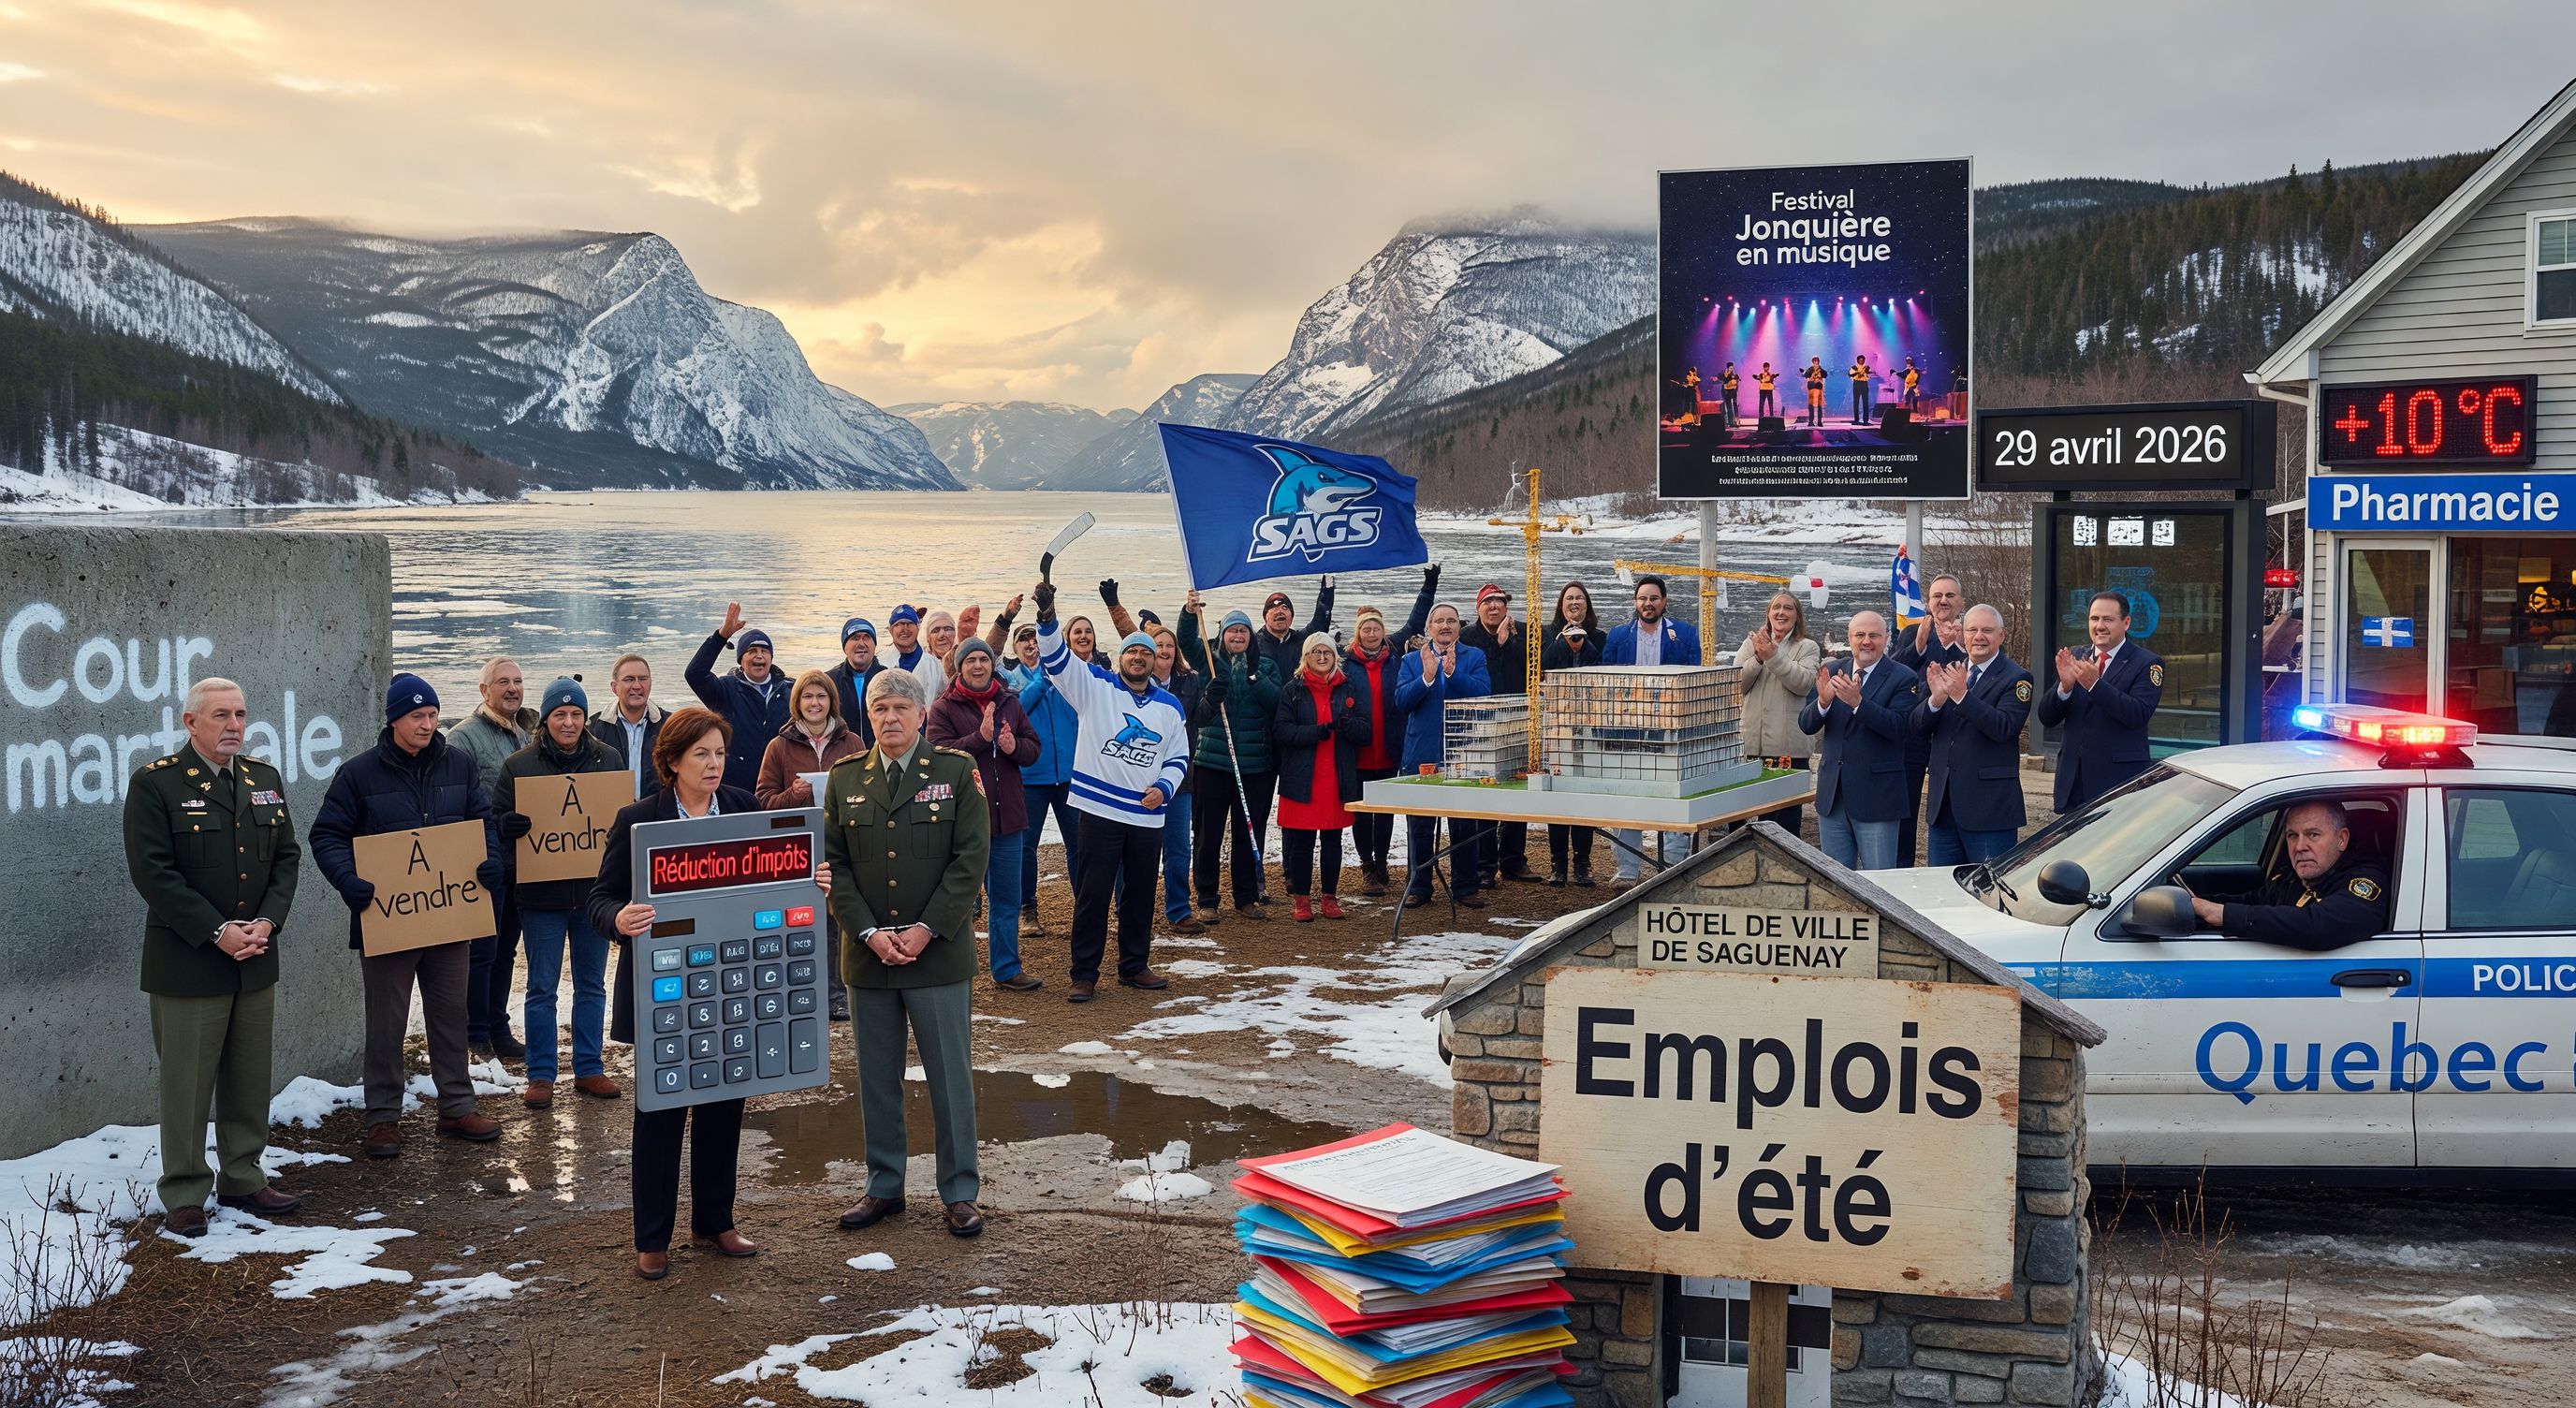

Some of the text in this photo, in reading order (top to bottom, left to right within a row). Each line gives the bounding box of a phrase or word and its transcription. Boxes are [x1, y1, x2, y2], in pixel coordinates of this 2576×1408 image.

[1772, 189, 1854, 212] Festival
[1735, 210, 1891, 245] Jonquière
[1736, 239, 1891, 269] en musique
[2335, 388, 2522, 455] +10°C
[1995, 424, 2227, 466] 29 avril 2026
[2333, 482, 2559, 521] Pharmacie
[1255, 511, 1378, 554] SAGS
[1, 603, 213, 709] Cour
[6, 690, 343, 814] martale
[561, 775, 583, 816] À
[407, 831, 431, 875] À
[654, 851, 736, 886] Réduction
[374, 871, 479, 918] vendre
[1647, 906, 1869, 941] HÔTEL DE VILLE
[1651, 940, 1849, 969] DE SAGUENAY
[1575, 1006, 1983, 1130] Emplois
[2195, 1021, 2549, 1106] Quebec
[1644, 1142, 1892, 1247] d’été
